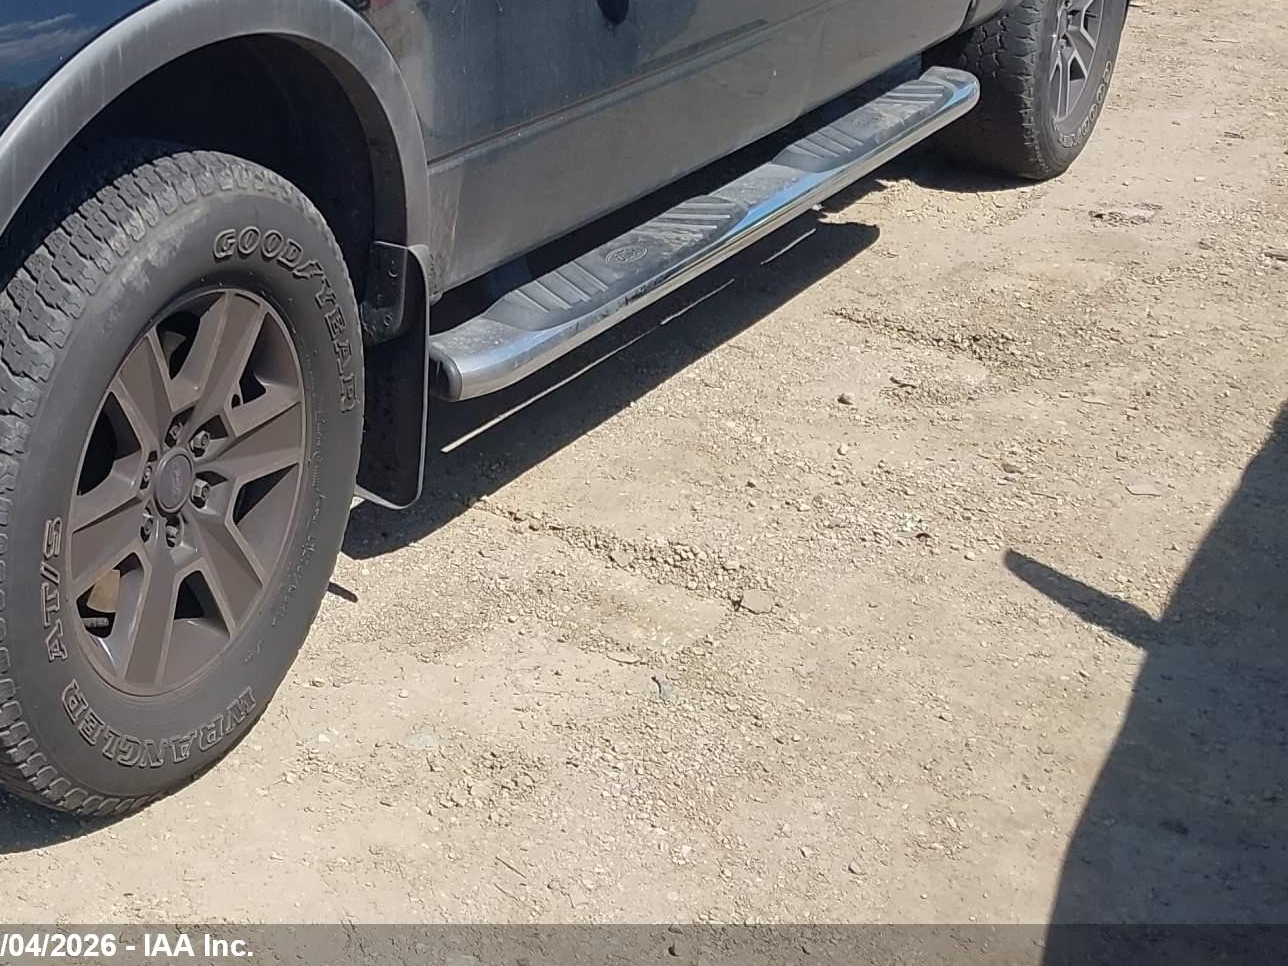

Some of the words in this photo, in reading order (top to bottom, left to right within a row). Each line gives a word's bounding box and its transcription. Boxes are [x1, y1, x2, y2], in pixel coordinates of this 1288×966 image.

[213, 226, 360, 413] GOODYEAR
[40, 517, 68, 662] AT/S
[62, 679, 257, 768] WRANGLER
